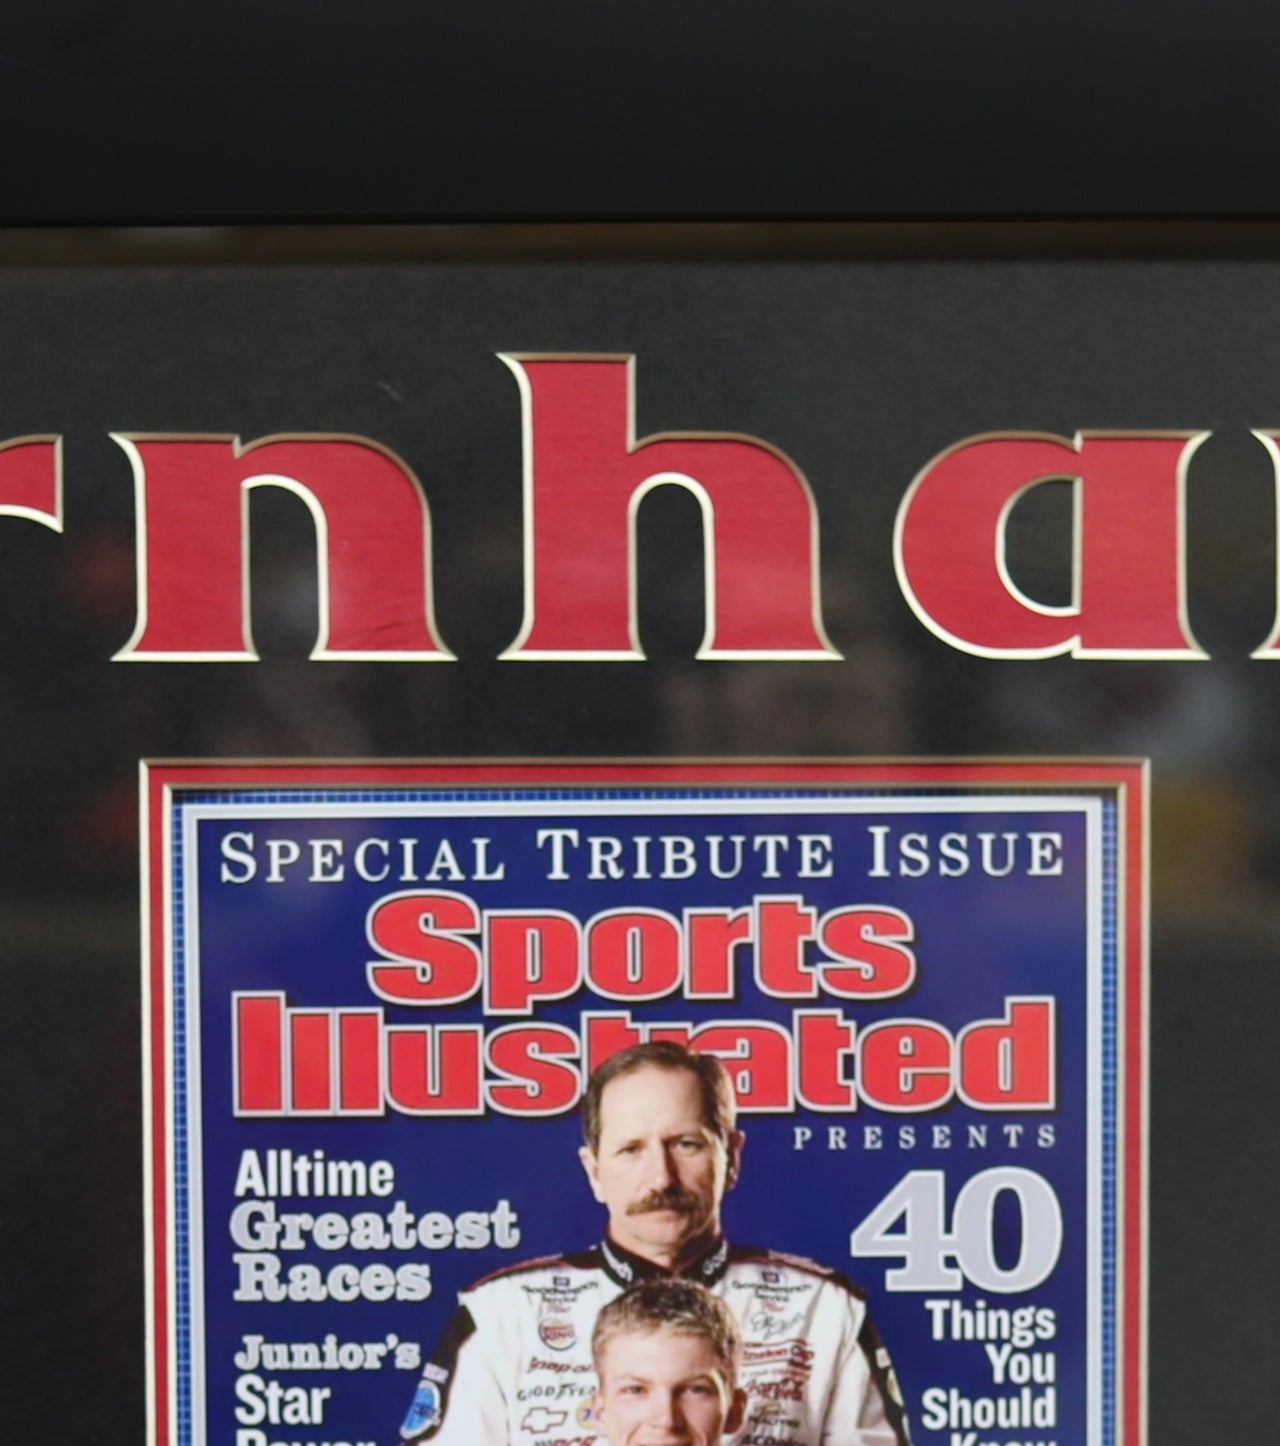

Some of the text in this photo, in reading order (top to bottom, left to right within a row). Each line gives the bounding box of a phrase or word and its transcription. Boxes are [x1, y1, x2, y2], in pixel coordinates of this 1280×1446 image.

[219, 826, 1064, 883] SPECIAL TRIBUTE ISSUE
[366, 891, 916, 1014] Sports
[794, 1124, 1056, 1150] PRESENTS
[234, 1149, 395, 1196] Alltime
[230, 1200, 521, 1249] Greatest
[850, 1165, 1063, 1293] 40
[233, 1254, 431, 1301] Races
[925, 1300, 1056, 1347] Things
[234, 1334, 420, 1370] Junior's
[985, 1344, 1055, 1384] You
[234, 1374, 330, 1424] Star
[922, 1388, 1056, 1429] Should
